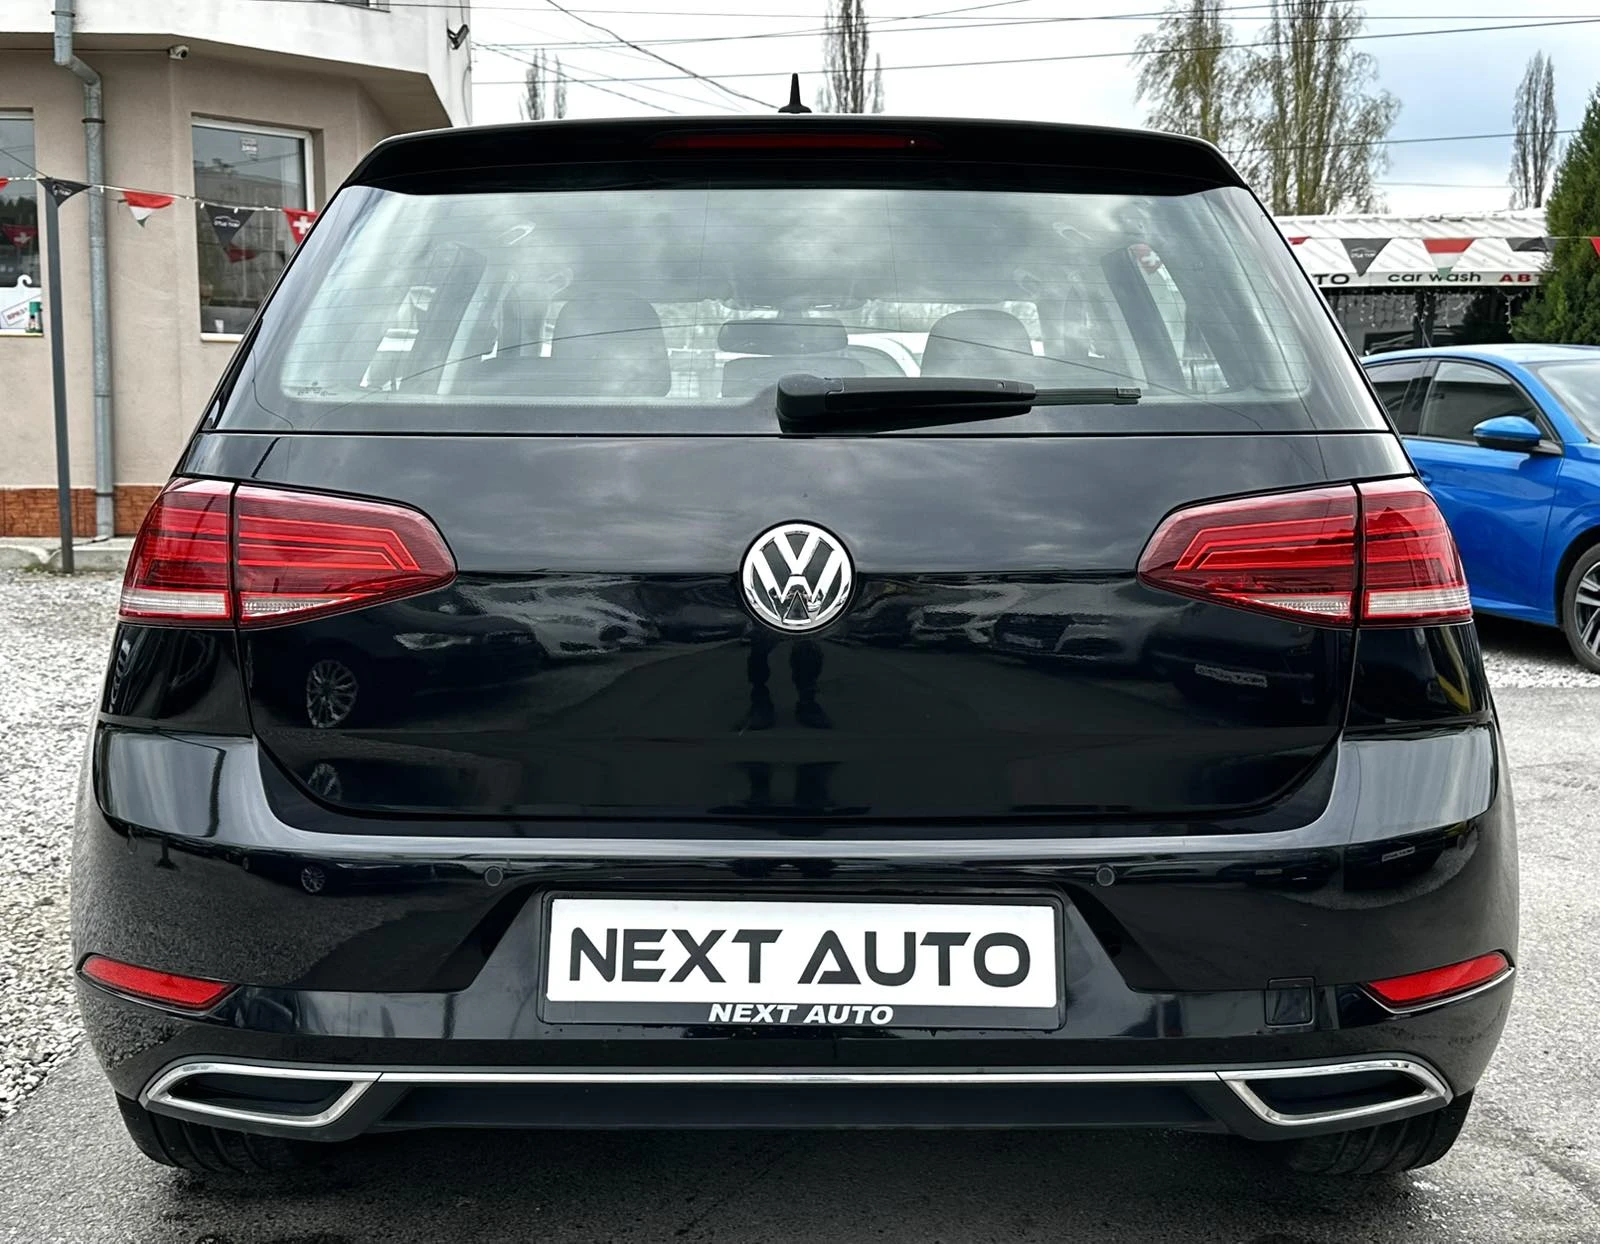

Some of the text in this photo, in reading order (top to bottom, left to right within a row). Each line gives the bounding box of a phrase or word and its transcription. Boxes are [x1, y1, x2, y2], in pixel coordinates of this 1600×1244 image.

[1388, 271, 1481, 282] car wash
[569, 926, 1031, 987] NEXT AUTO
[708, 1003, 894, 1025] NEXT AUTO
